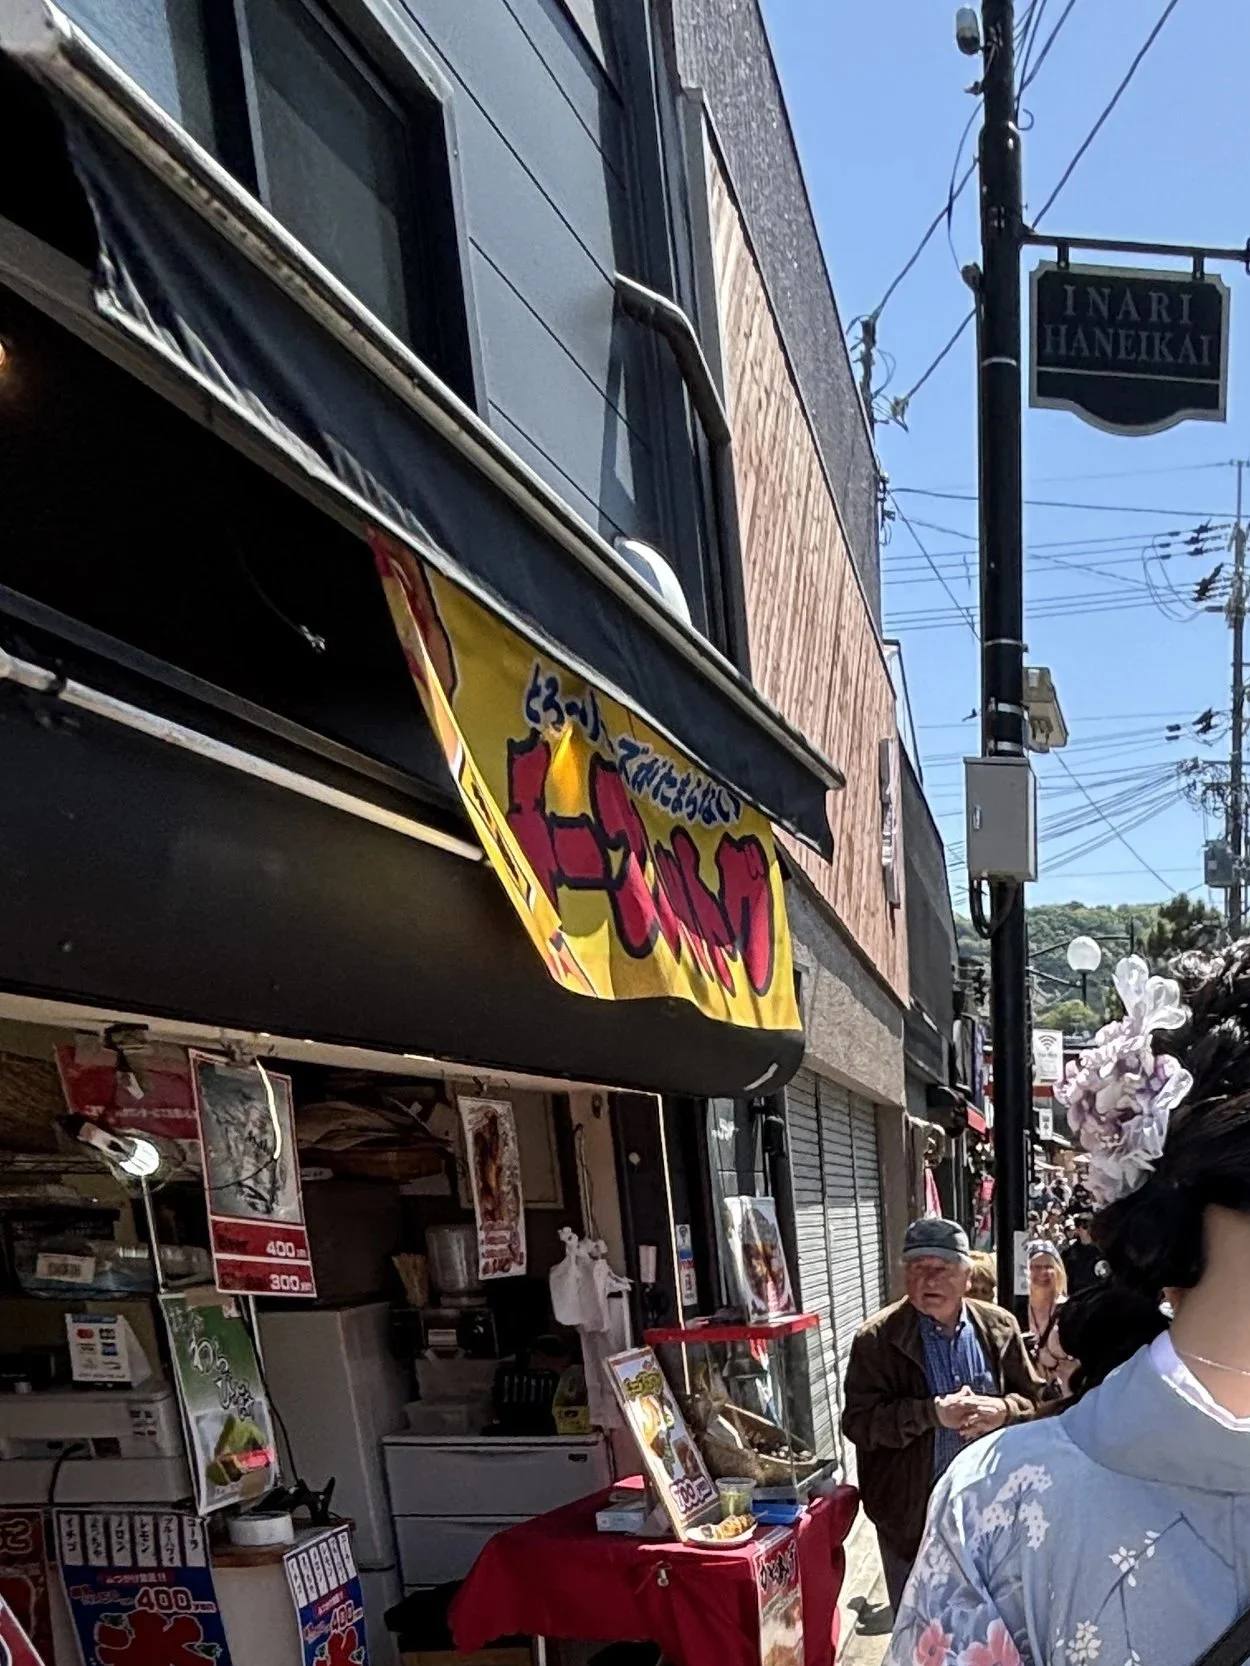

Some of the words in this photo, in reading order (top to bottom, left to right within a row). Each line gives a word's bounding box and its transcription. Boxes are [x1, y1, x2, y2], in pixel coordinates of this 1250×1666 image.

[1063, 284, 1193, 325] INARI
[1043, 323, 1212, 366] HANEIKAI
[139, 1517, 150, 1553] レモン
